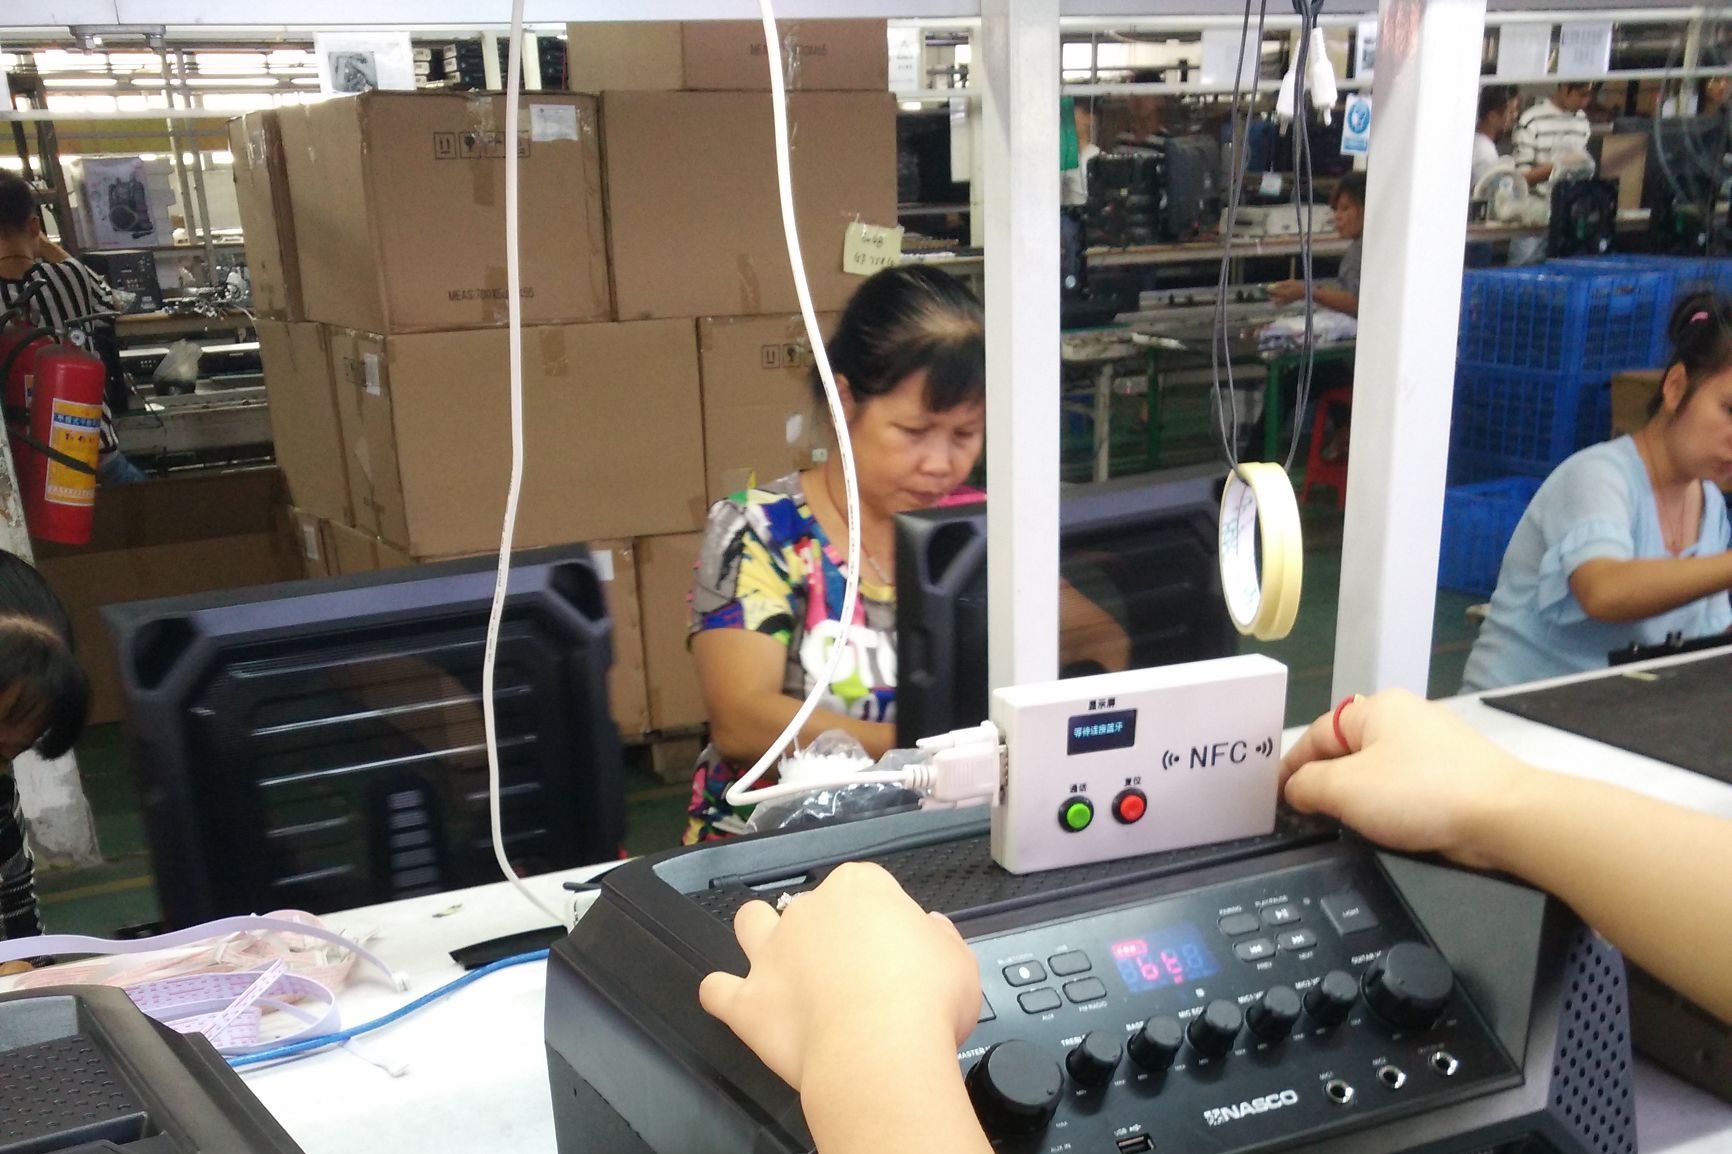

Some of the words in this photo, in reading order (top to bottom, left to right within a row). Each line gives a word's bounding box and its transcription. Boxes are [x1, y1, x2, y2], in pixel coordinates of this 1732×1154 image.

[1074, 722, 1123, 738] 等待连接蓝牙
[1190, 741, 1247, 768] NFC
[1219, 1089, 1298, 1122] NASCO
